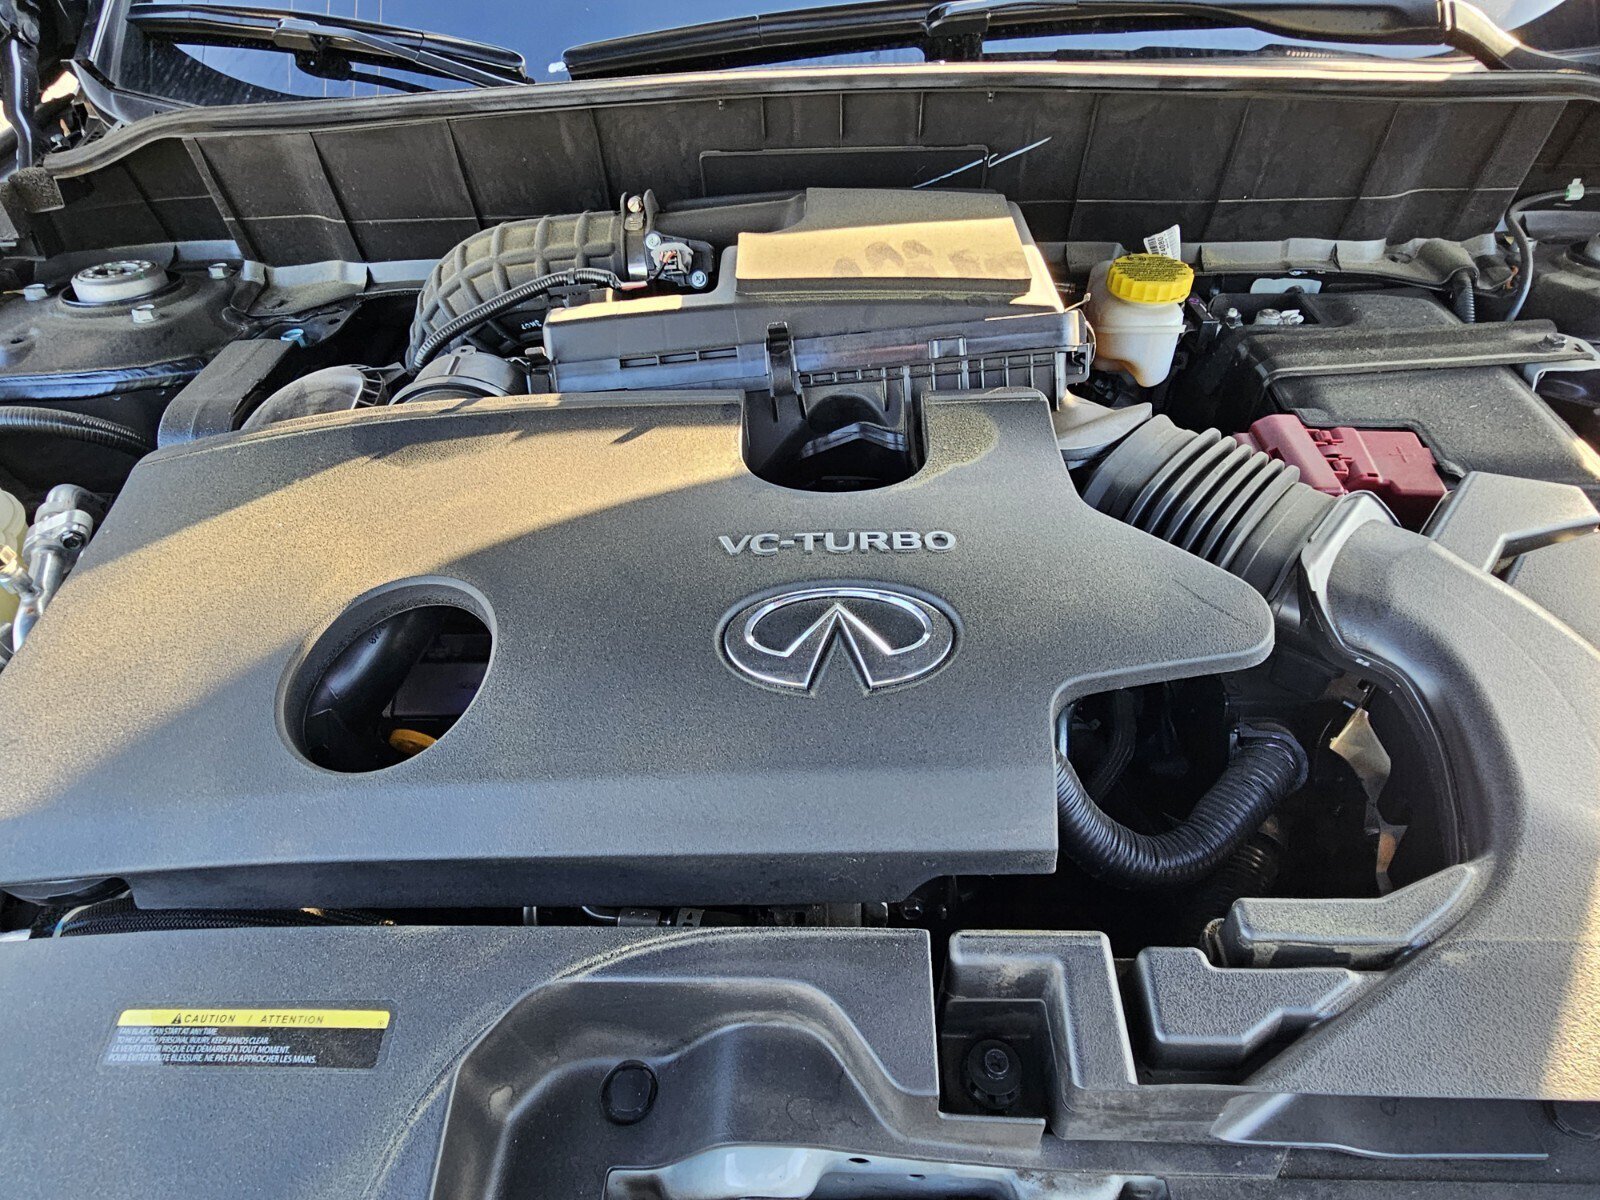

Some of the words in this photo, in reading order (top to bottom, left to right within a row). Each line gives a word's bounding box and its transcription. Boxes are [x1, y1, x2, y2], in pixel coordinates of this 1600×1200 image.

[718, 531, 957, 555] VC-TURBO
[184, 1014, 236, 1024] CAUTION
[260, 1015, 324, 1025] ATTENTION
[164, 1027, 182, 1035] START
[181, 1027, 191, 1035] AT
[190, 1027, 204, 1035] ANY
[159, 1036, 188, 1044] PERSONAL
[210, 1036, 226, 1045] KEEP
[226, 1036, 249, 1045] HANDS
[162, 1045, 187, 1053] RISQUE
[186, 1045, 197, 1053] DE
[239, 1045, 258, 1054] TOUT
[257, 1045, 290, 1054] MOMENT.
[149, 1053, 171, 1061] TOUTE
[204, 1054, 216, 1062] NE
[215, 1054, 228, 1062] PAS
[228, 1054, 239, 1063] EN
[239, 1055, 280, 1063] APPROCHER
[280, 1055, 293, 1063] LES
[292, 1055, 317, 1064] MAINS.
